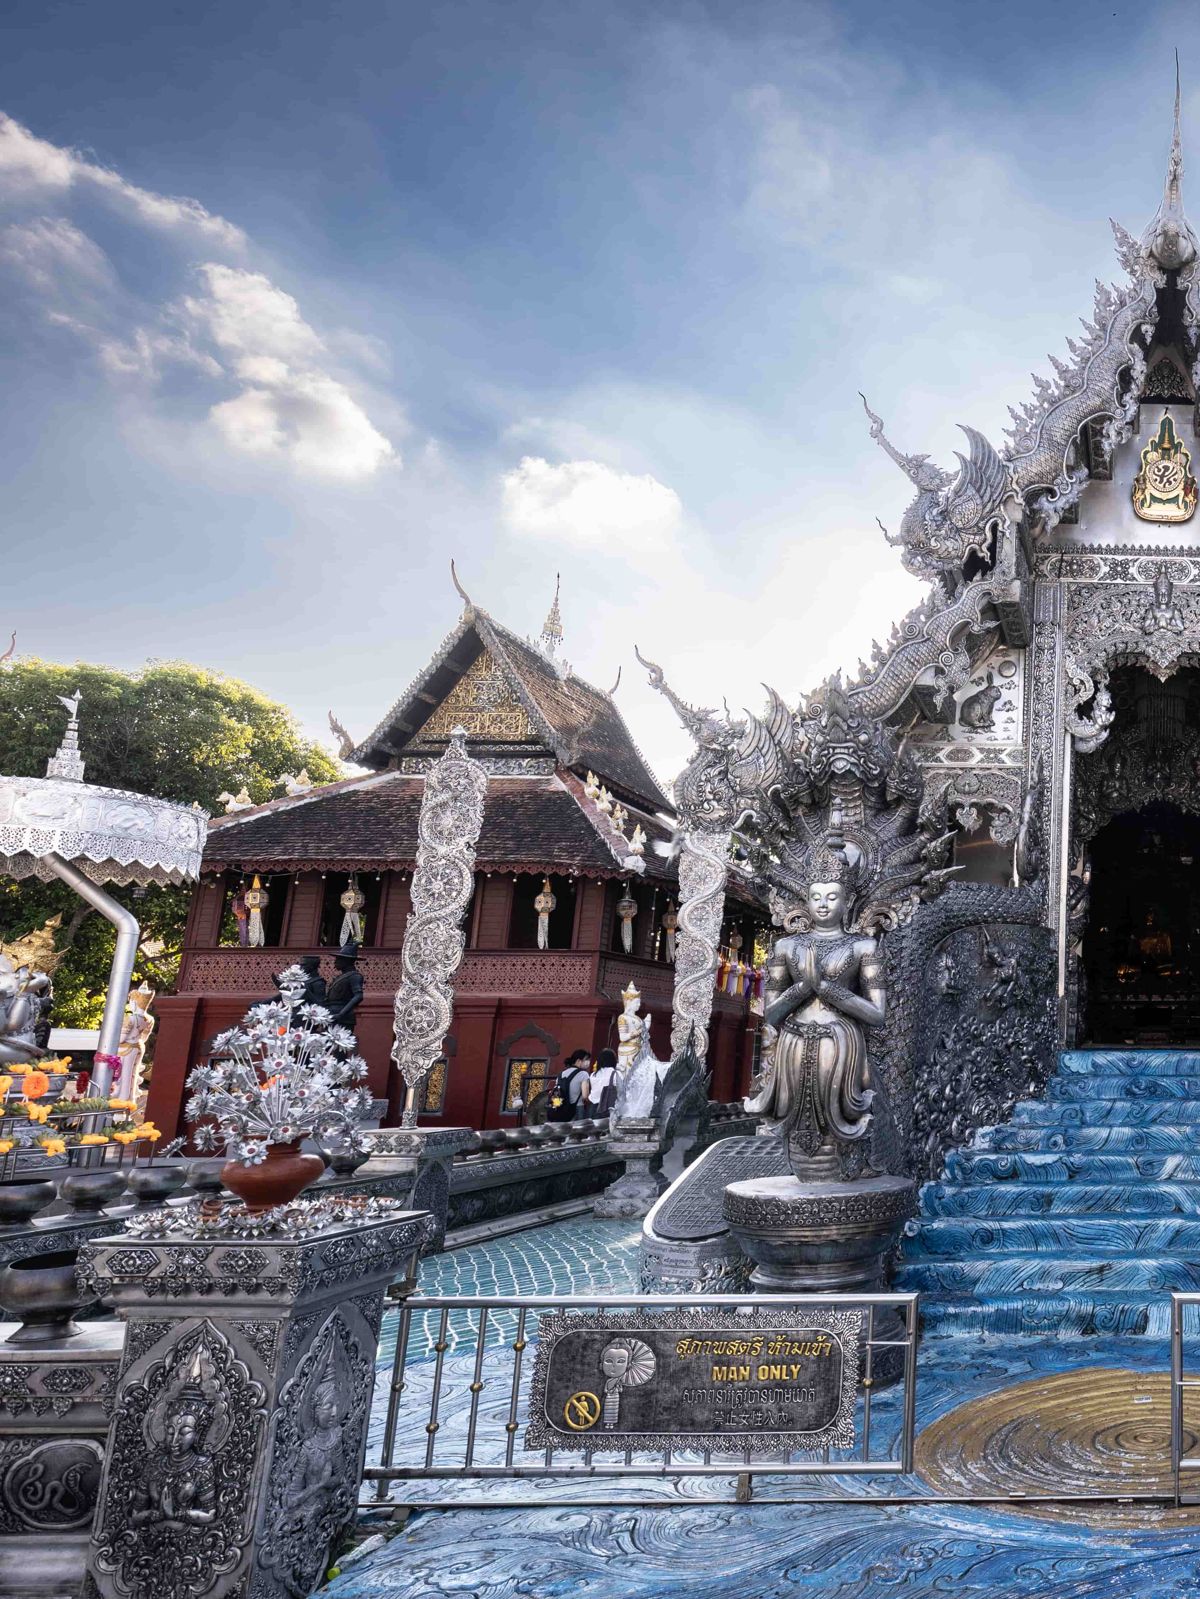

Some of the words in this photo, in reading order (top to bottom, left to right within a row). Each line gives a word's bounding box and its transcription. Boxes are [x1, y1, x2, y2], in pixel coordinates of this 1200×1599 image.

[676, 1336, 764, 1360] สุภาพสตรี
[768, 1335, 832, 1356] ห้ามเข้า
[712, 1366, 750, 1382] MAN
[758, 1364, 801, 1380] ONLY
